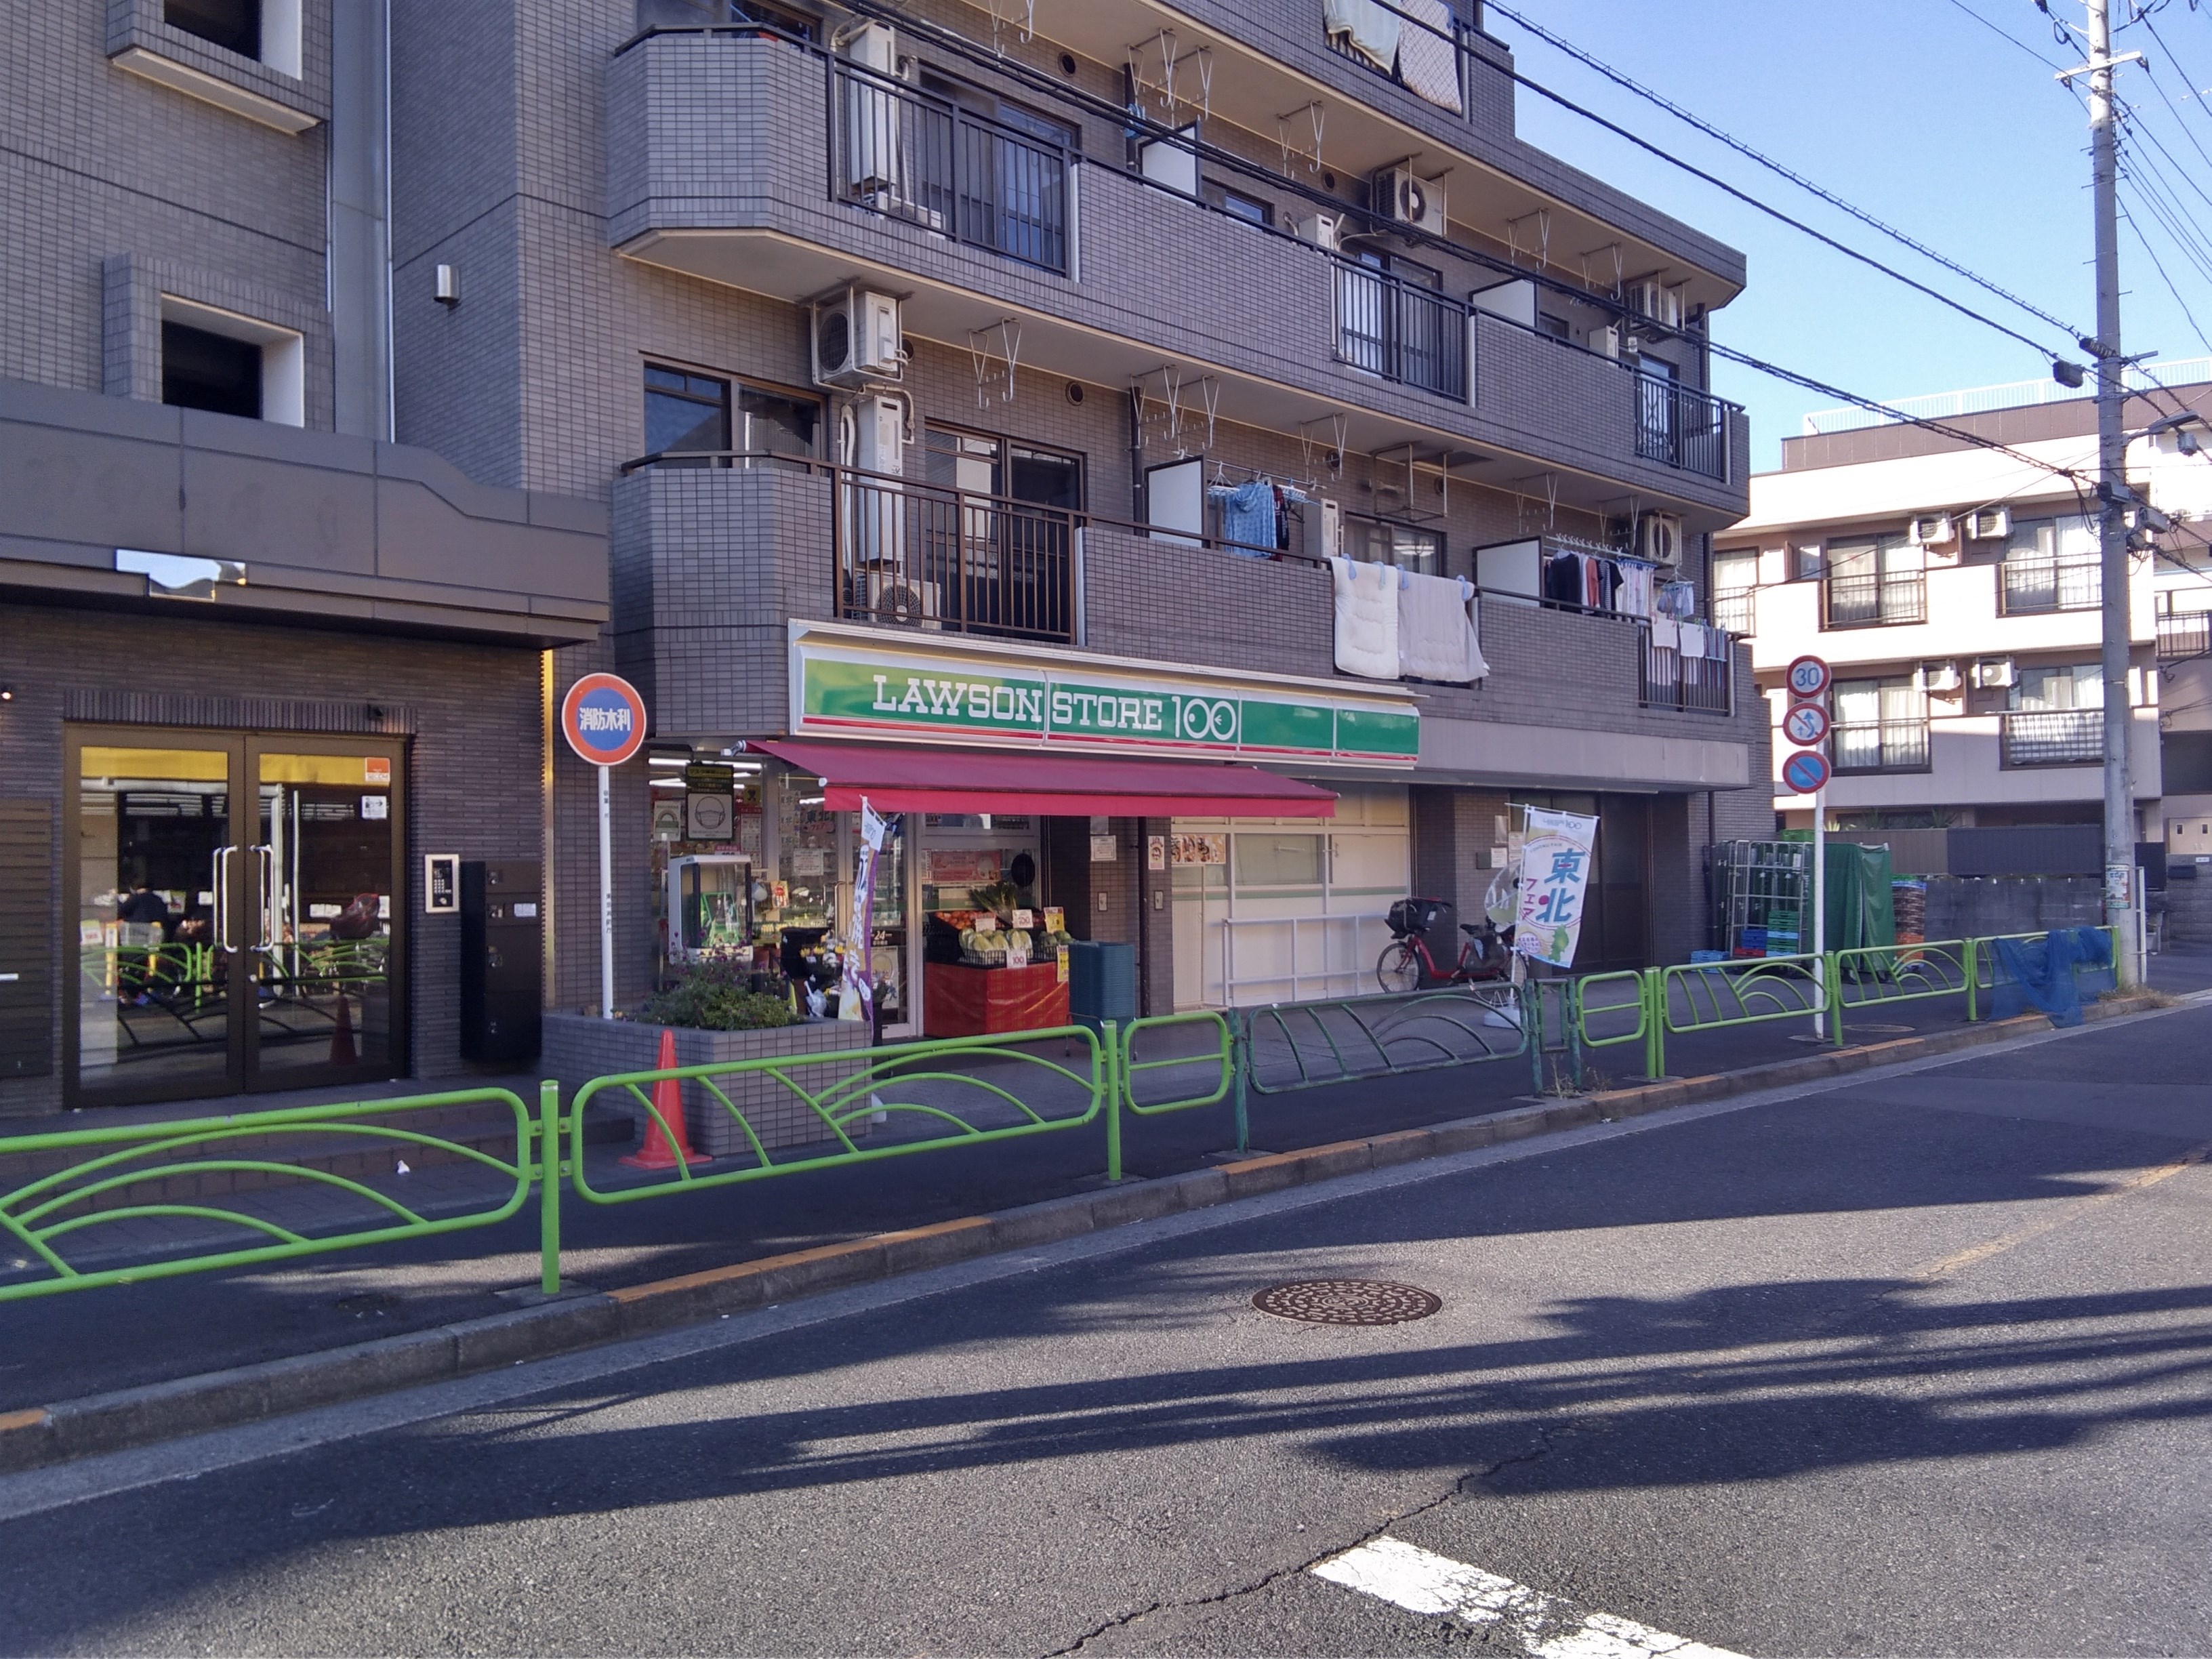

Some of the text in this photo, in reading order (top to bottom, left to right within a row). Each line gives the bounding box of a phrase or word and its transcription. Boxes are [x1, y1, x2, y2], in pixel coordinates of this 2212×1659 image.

[1796, 667, 1819, 686] 30
[579, 707, 631, 731] 消防水利
[872, 674, 1237, 741] LAWSON STORE 100
[1521, 878, 1538, 920] フェア
[1535, 847, 1586, 922] 東北
[874, 930, 886, 941] 24
